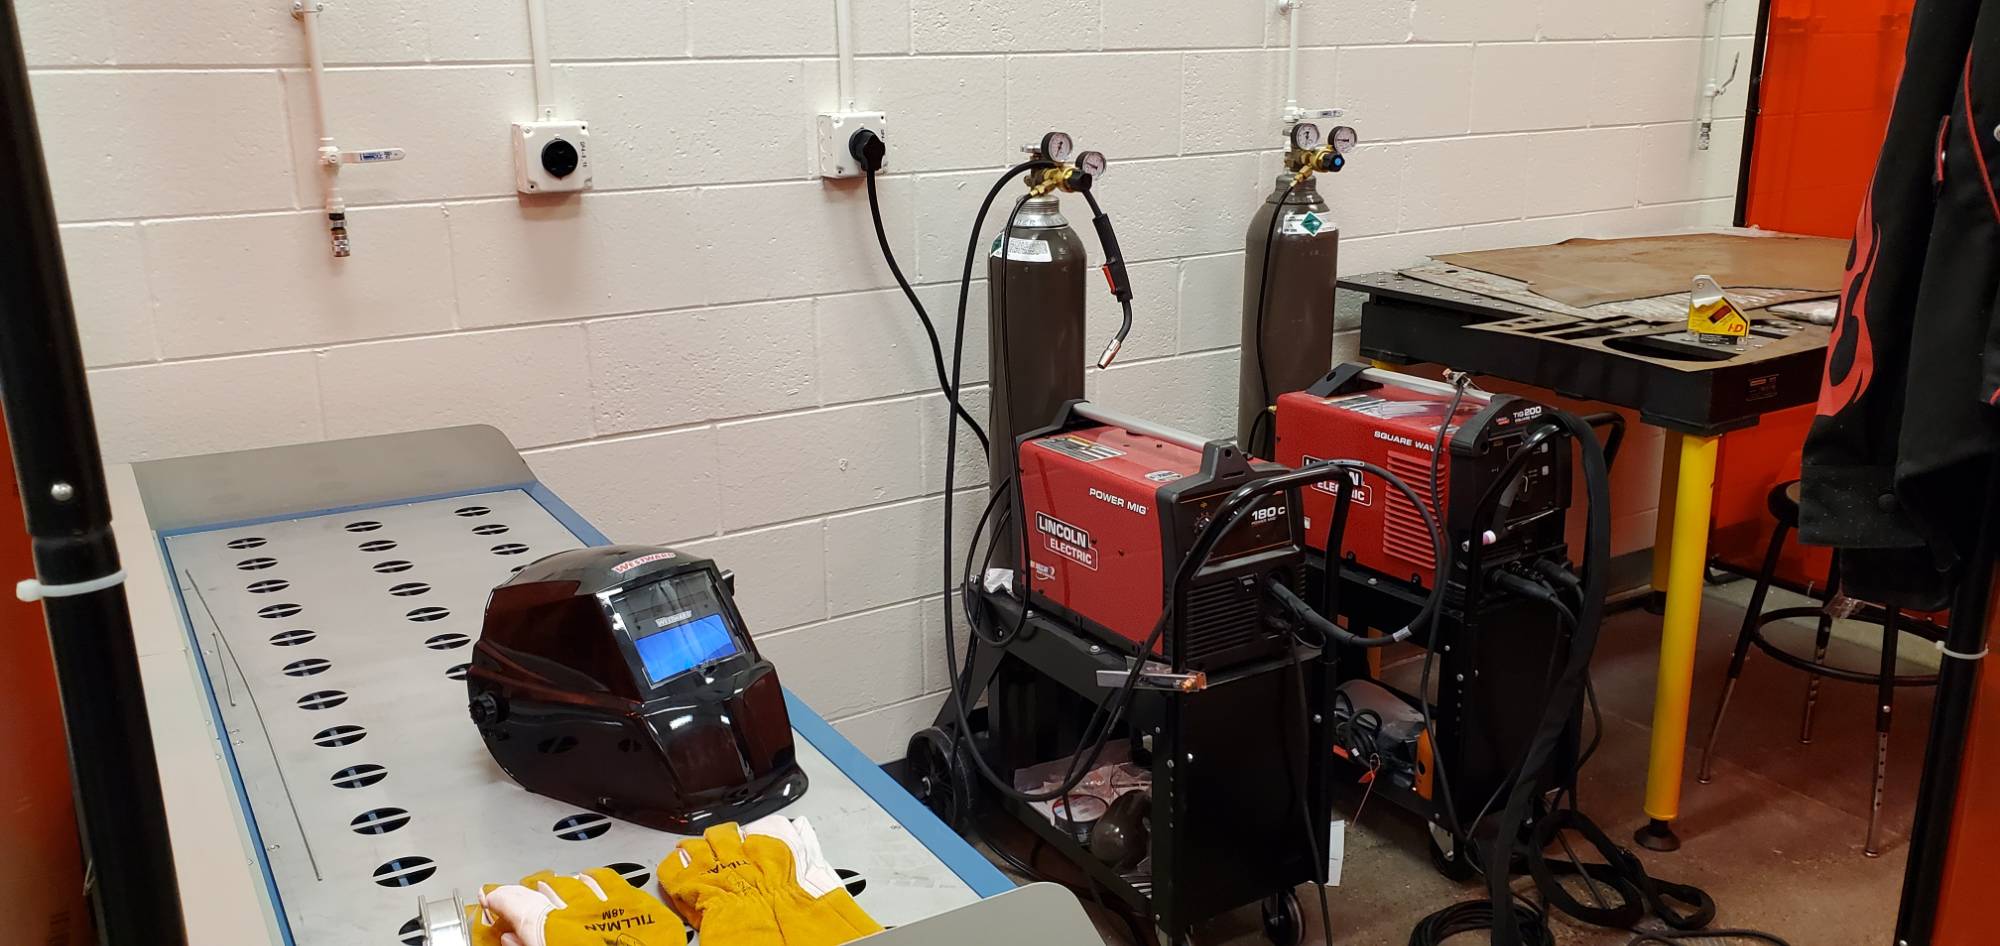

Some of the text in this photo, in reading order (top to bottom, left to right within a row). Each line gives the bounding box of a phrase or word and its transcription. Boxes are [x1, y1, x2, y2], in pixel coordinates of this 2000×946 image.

[1524, 405, 1542, 416] 200
[1374, 430, 1412, 446] SQUARE
[1317, 480, 1365, 501] ELEIC
[1089, 488, 1147, 515] POWER MIG
[1251, 506, 1276, 521] 180
[1039, 515, 1086, 548] LINCOLN
[1050, 537, 1092, 565] ELECTRIC
[584, 914, 656, 932] TILLMAN
[602, 908, 625, 920] 48M
